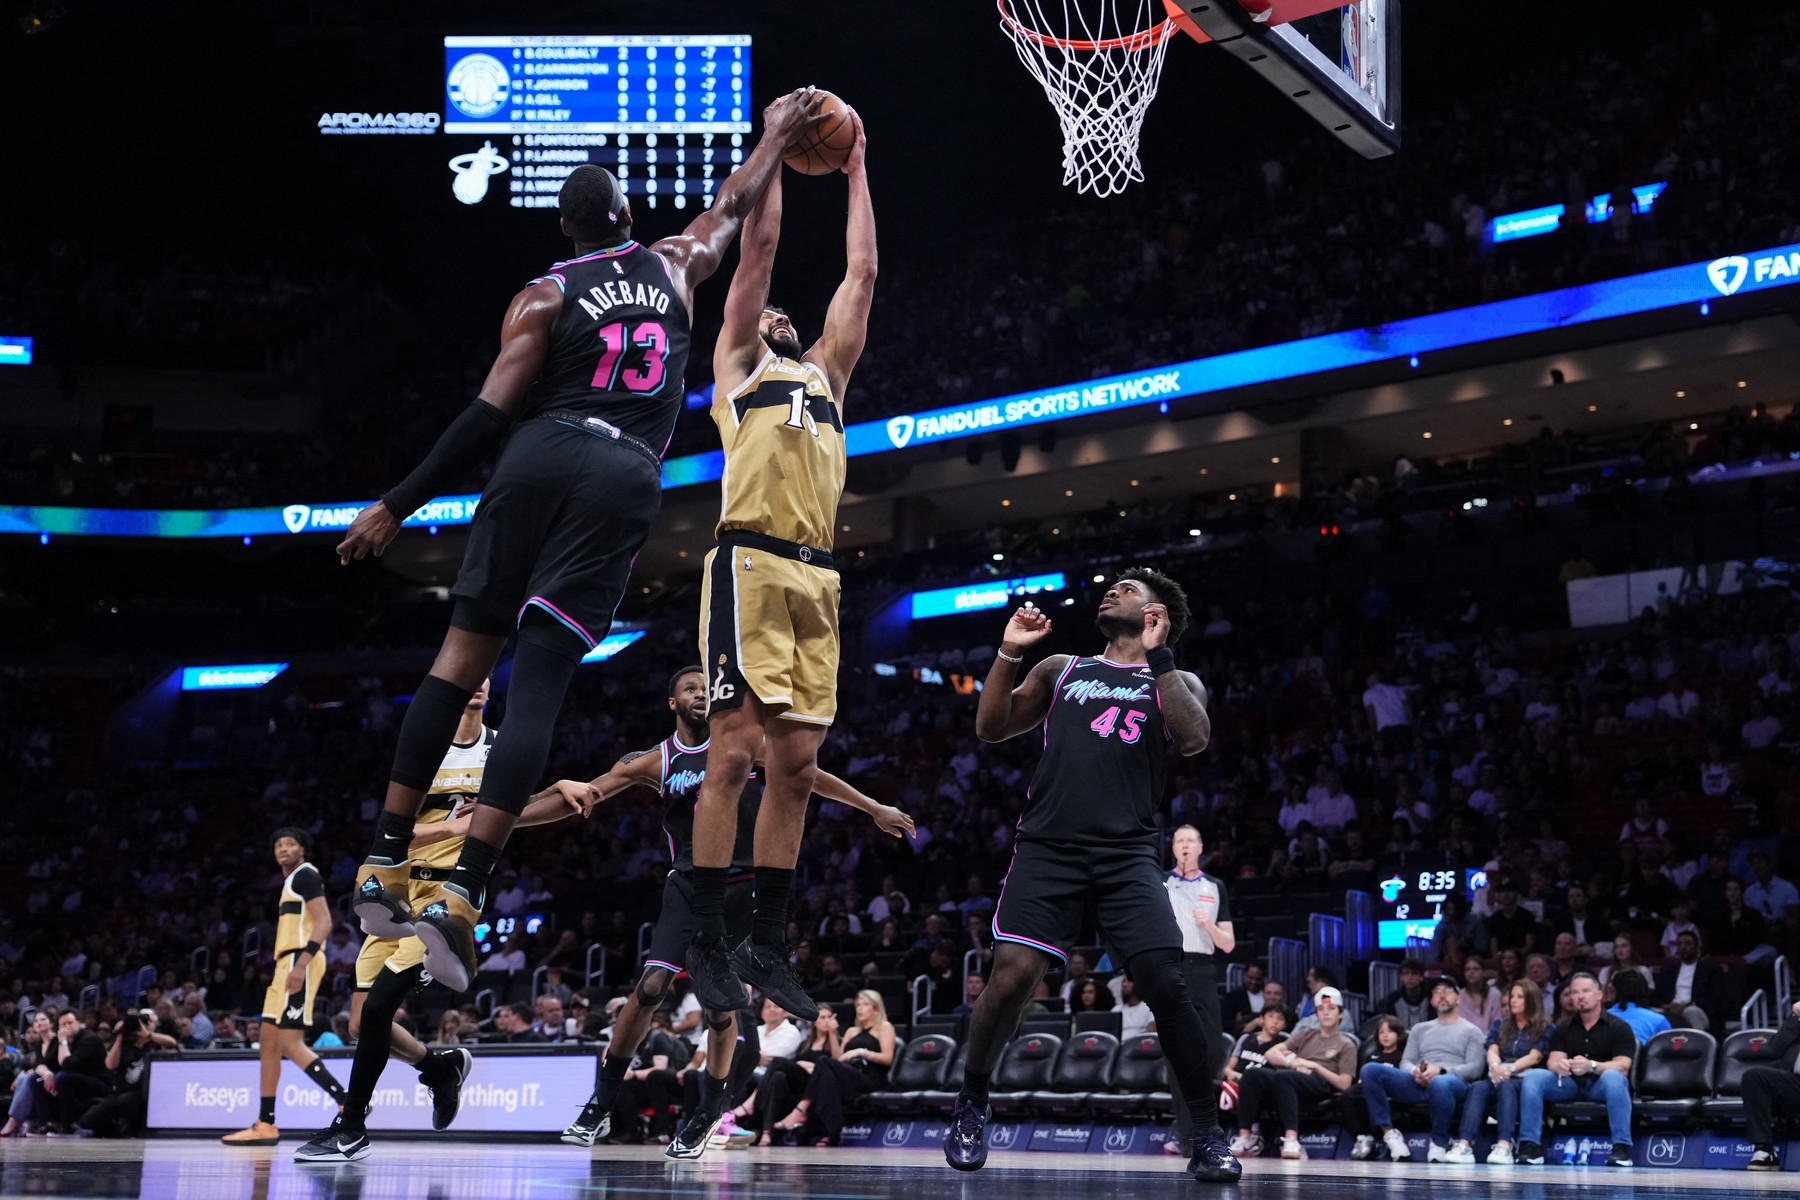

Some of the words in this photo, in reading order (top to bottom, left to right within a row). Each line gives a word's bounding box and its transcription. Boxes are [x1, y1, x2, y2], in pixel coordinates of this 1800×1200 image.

[646, 46, 658, 61] 0
[674, 46, 686, 61] 0
[733, 46, 742, 61] 1
[617, 61, 629, 76] 0
[647, 61, 657, 76] 1
[674, 61, 686, 76] 0
[731, 61, 743, 76] 0
[617, 77, 629, 92] 0
[646, 77, 658, 92] 0
[674, 77, 686, 92] 0
[731, 77, 743, 92] 0
[617, 92, 629, 107] 0
[647, 92, 657, 107] 1
[674, 92, 686, 107] 0
[733, 92, 742, 107] 1
[318, 112, 441, 128] AROMA360
[646, 107, 658, 122] 0
[674, 107, 686, 122] 0
[731, 107, 743, 122] 0
[617, 133, 629, 148] 0
[646, 133, 658, 148] 0
[675, 133, 685, 148] 1
[702, 133, 714, 148] 7
[731, 133, 743, 148] 0
[675, 148, 685, 163] 1
[702, 148, 714, 163] 7
[731, 148, 743, 163] 0
[647, 164, 657, 179] 1
[675, 164, 685, 179] 1
[702, 164, 714, 179] 7
[646, 179, 658, 194] 0
[674, 179, 686, 194] 0
[702, 179, 714, 194] 7
[674, 194, 686, 209] 0
[702, 194, 714, 209] 7
[578, 280, 670, 321] ADEBAYO
[590, 321, 670, 397] 13
[916, 405, 1004, 439] FANDUEL
[1005, 391, 1080, 423] SPORTS
[1082, 371, 1181, 408] NETWORK
[1063, 679, 1152, 706] Miami
[1090, 706, 1148, 744] 45
[1418, 870, 1456, 891] 8:35
[184, 1082, 250, 1113] Kaseya
[283, 1084, 321, 1107] One
[521, 1083, 544, 1107] IT.
[1033, 1130, 1049, 1139] ONE
[1150, 1133, 1166, 1141] ONE
[1408, 1138, 1426, 1147] ONE
[1708, 1145, 1728, 1154] ONE
